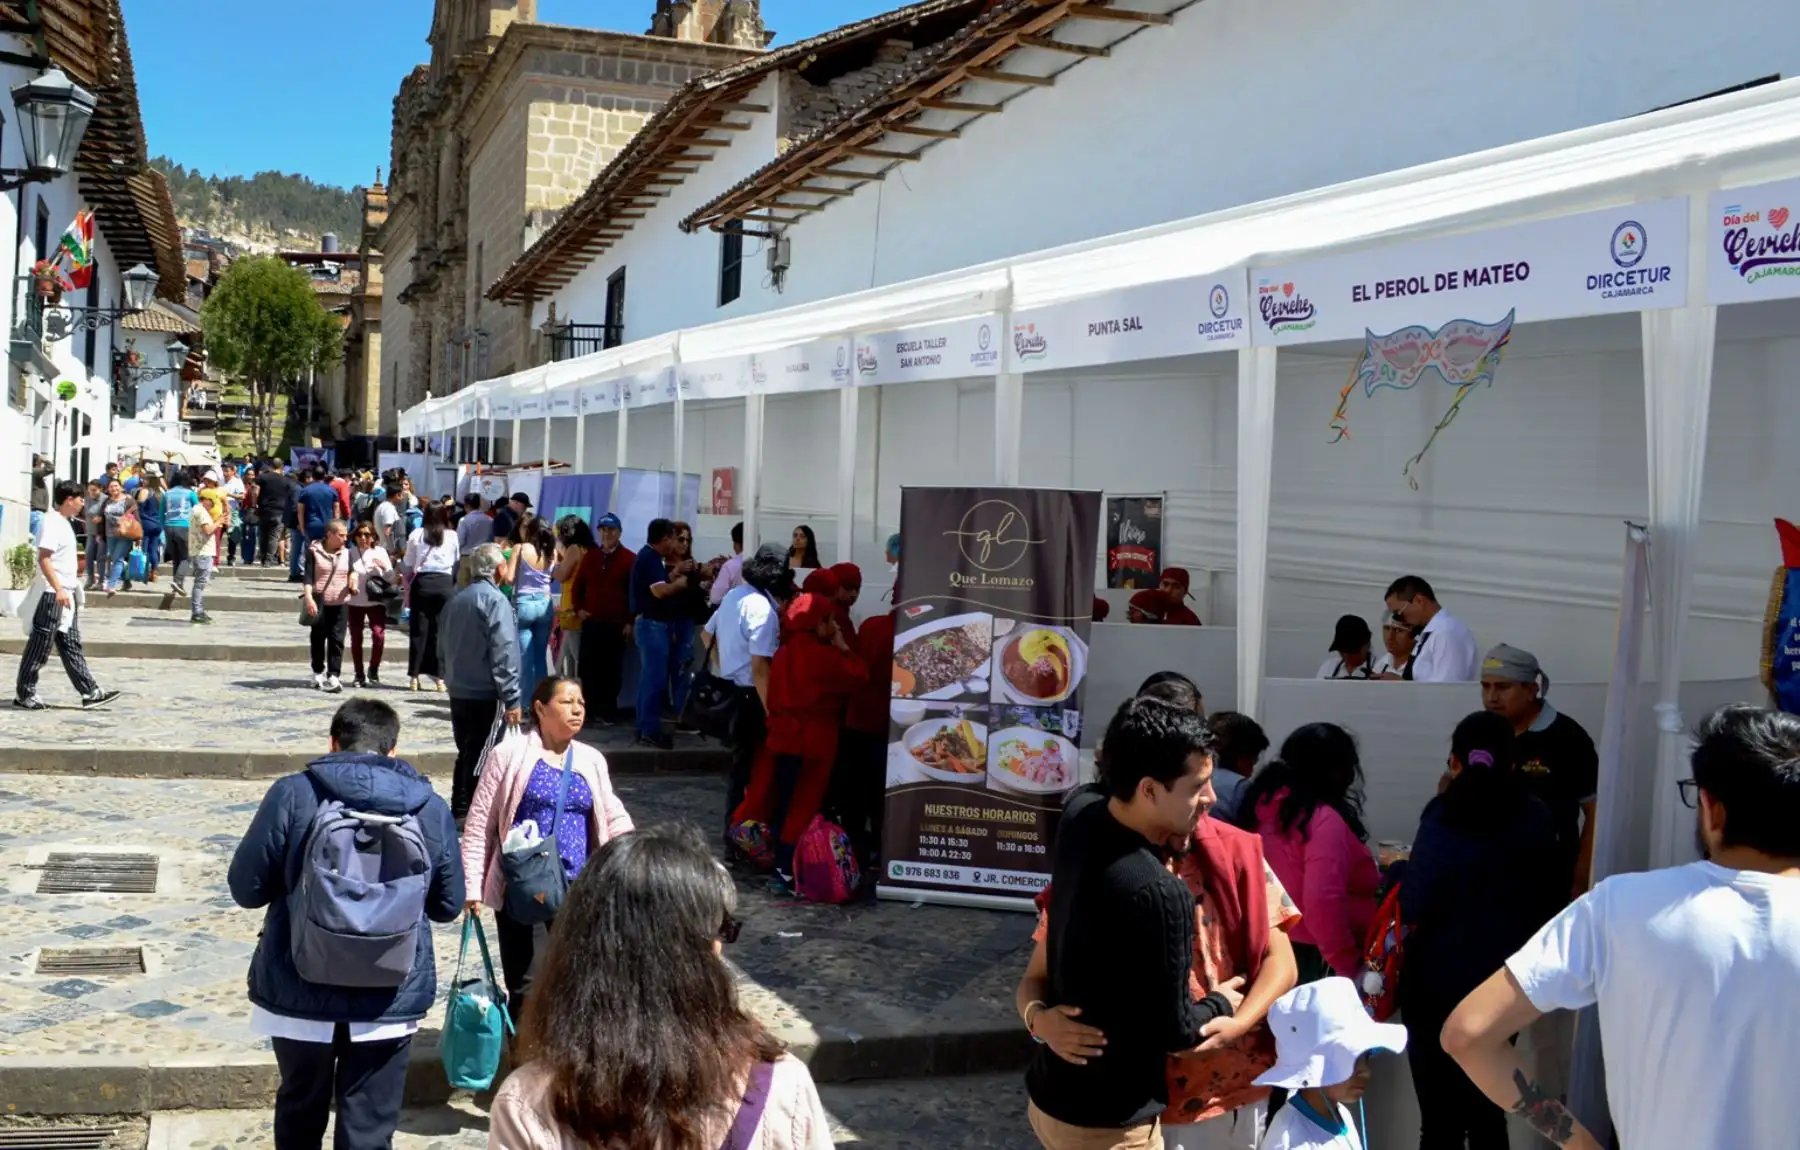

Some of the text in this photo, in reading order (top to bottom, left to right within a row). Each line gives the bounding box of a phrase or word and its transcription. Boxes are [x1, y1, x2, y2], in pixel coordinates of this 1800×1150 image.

[1723, 211, 1760, 226] Día del
[1352, 261, 1530, 302] EL PEROL DE MATEO
[1586, 266, 1671, 290] DIRCETUR
[1601, 285, 1654, 299] CAJAMARCA
[1259, 293, 1315, 328] Ceviche
[1088, 316, 1143, 336] PUNTA SAL
[1198, 317, 1243, 335] DIRCETUR
[896, 337, 948, 354] ESCUELA TALLER
[914, 353, 942, 367] ANTONIO
[949, 571, 1035, 588] Que Lomazo
[924, 803, 1037, 823] NUESTROS HORARIOS
[920, 823, 988, 837] LUNES A SÁBADO
[997, 830, 1039, 841] DOMINGOS
[940, 837, 946, 845] A
[941, 849, 948, 858] A
[983, 872, 999, 884] JR.
